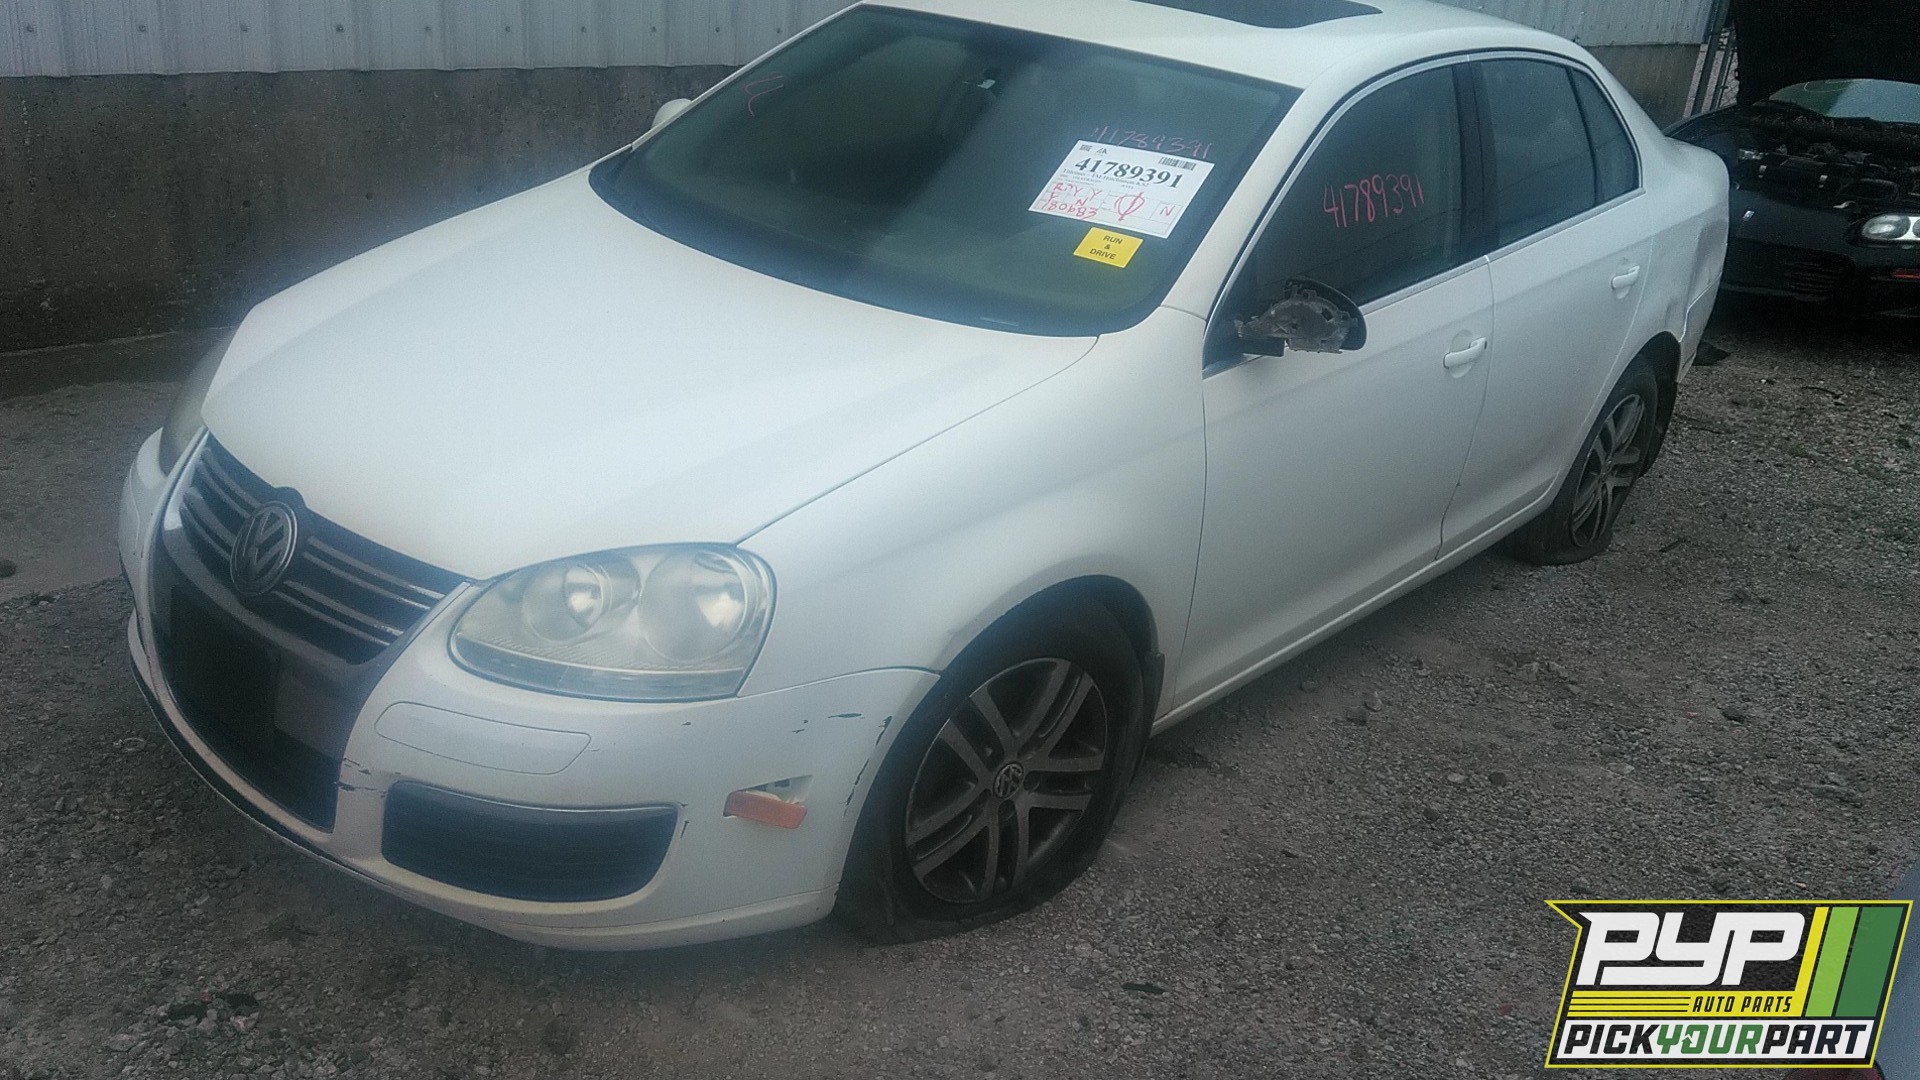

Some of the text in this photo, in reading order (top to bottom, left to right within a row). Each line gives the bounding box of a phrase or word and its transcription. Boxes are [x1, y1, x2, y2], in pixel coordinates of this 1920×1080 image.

[1075, 157, 1183, 188] 41789391
[1323, 172, 1424, 228] 41789391
[1159, 205, 1176, 217] N
[1103, 235, 1123, 245] RUN
[1089, 248, 1117, 260] DRIVE
